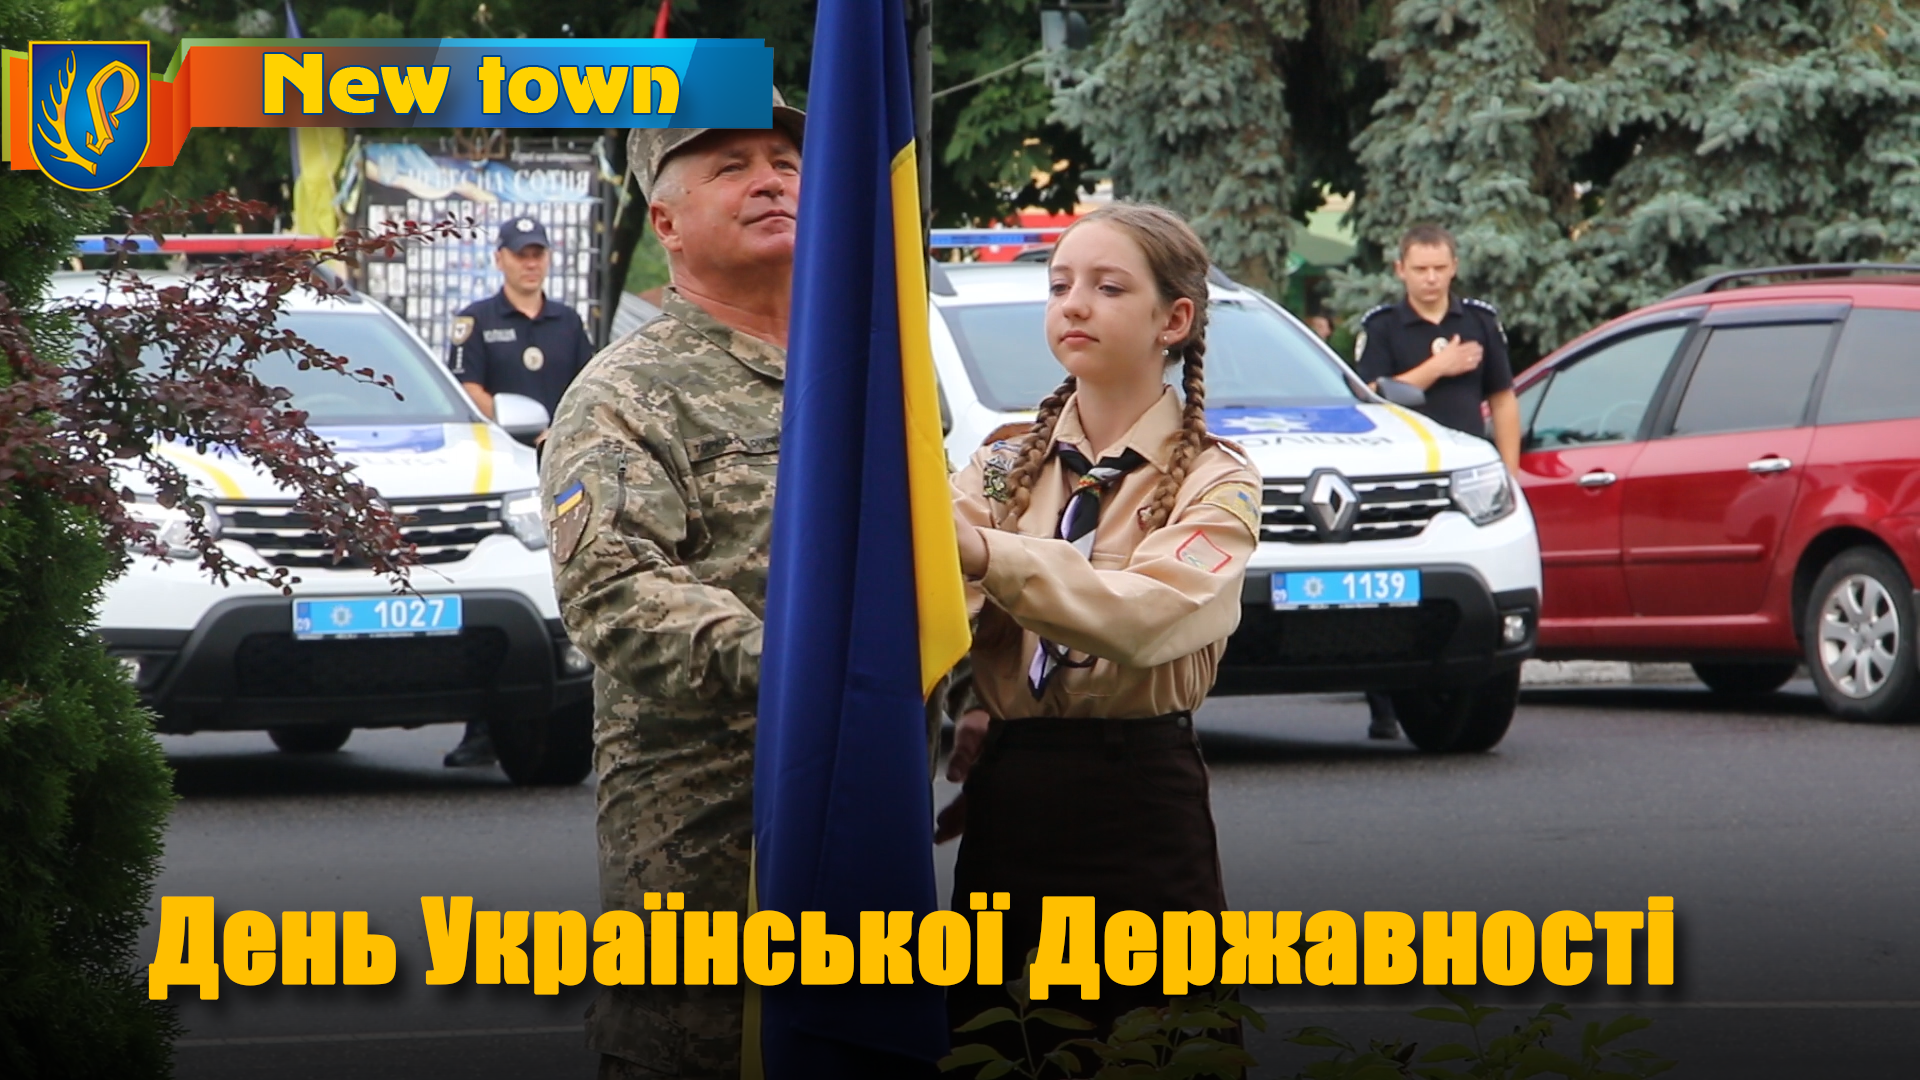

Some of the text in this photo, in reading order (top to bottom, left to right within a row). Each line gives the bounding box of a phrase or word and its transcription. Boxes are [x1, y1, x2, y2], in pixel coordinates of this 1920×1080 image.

[514, 168, 591, 195] СОТНЯ
[1237, 434, 1394, 448] ОЛІЦІЯ
[1342, 572, 1405, 599] 1139
[374, 599, 445, 628] 1027
